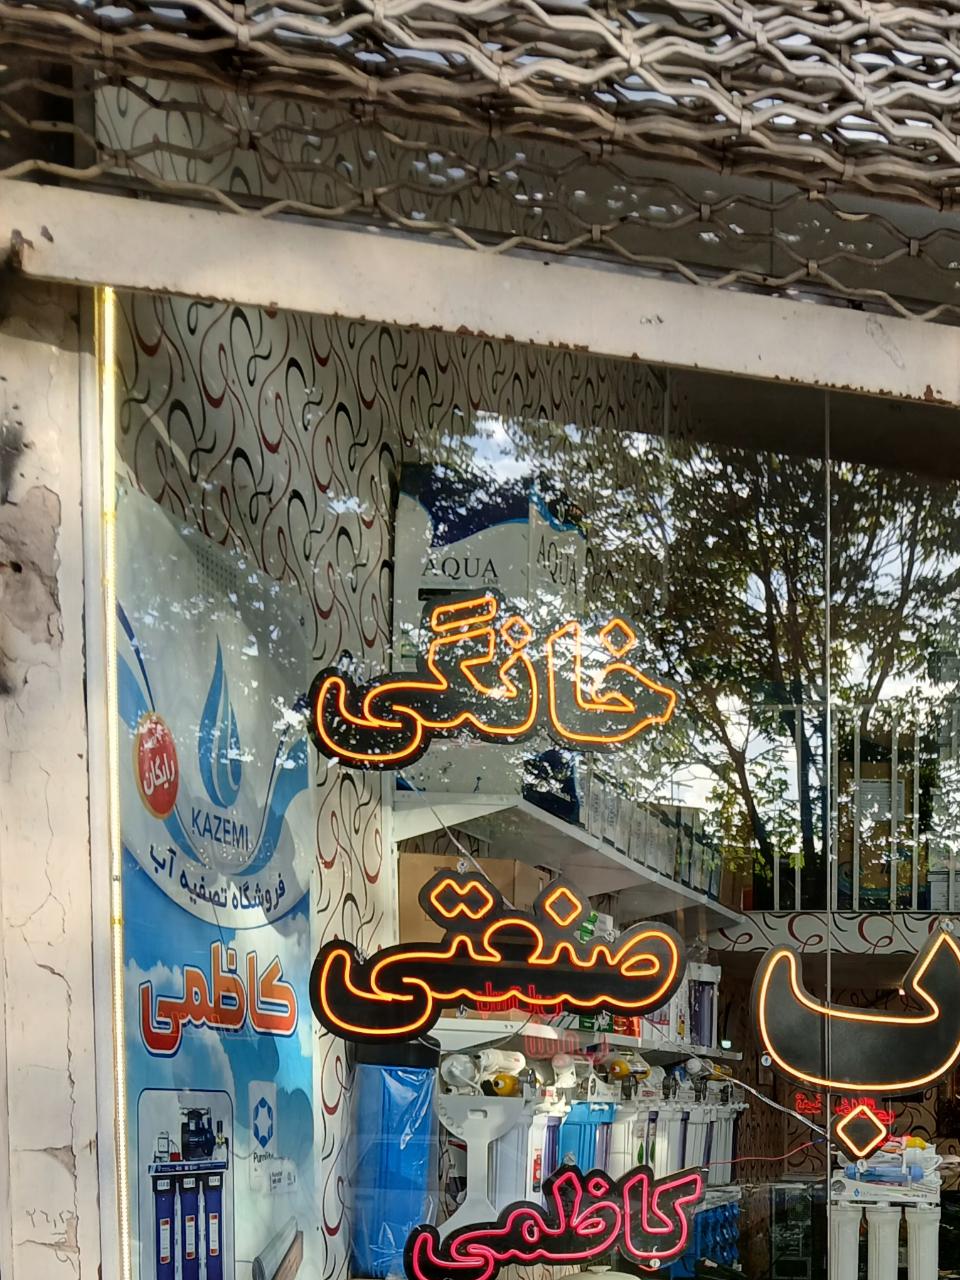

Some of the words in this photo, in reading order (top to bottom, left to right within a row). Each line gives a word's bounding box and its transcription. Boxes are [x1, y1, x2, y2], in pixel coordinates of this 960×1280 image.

[421, 556, 499, 580] AQUA
[536, 534, 578, 595] AQUA
[314, 594, 677, 763] خانگی
[143, 753, 176, 796] رایگان
[191, 807, 250, 851] KAZEMI
[149, 844, 177, 878] آب
[179, 869, 228, 909] تصفیه
[231, 873, 286, 912] فروشگاه
[319, 878, 681, 1037] صنعتی
[139, 939, 298, 1058] کاظمی
